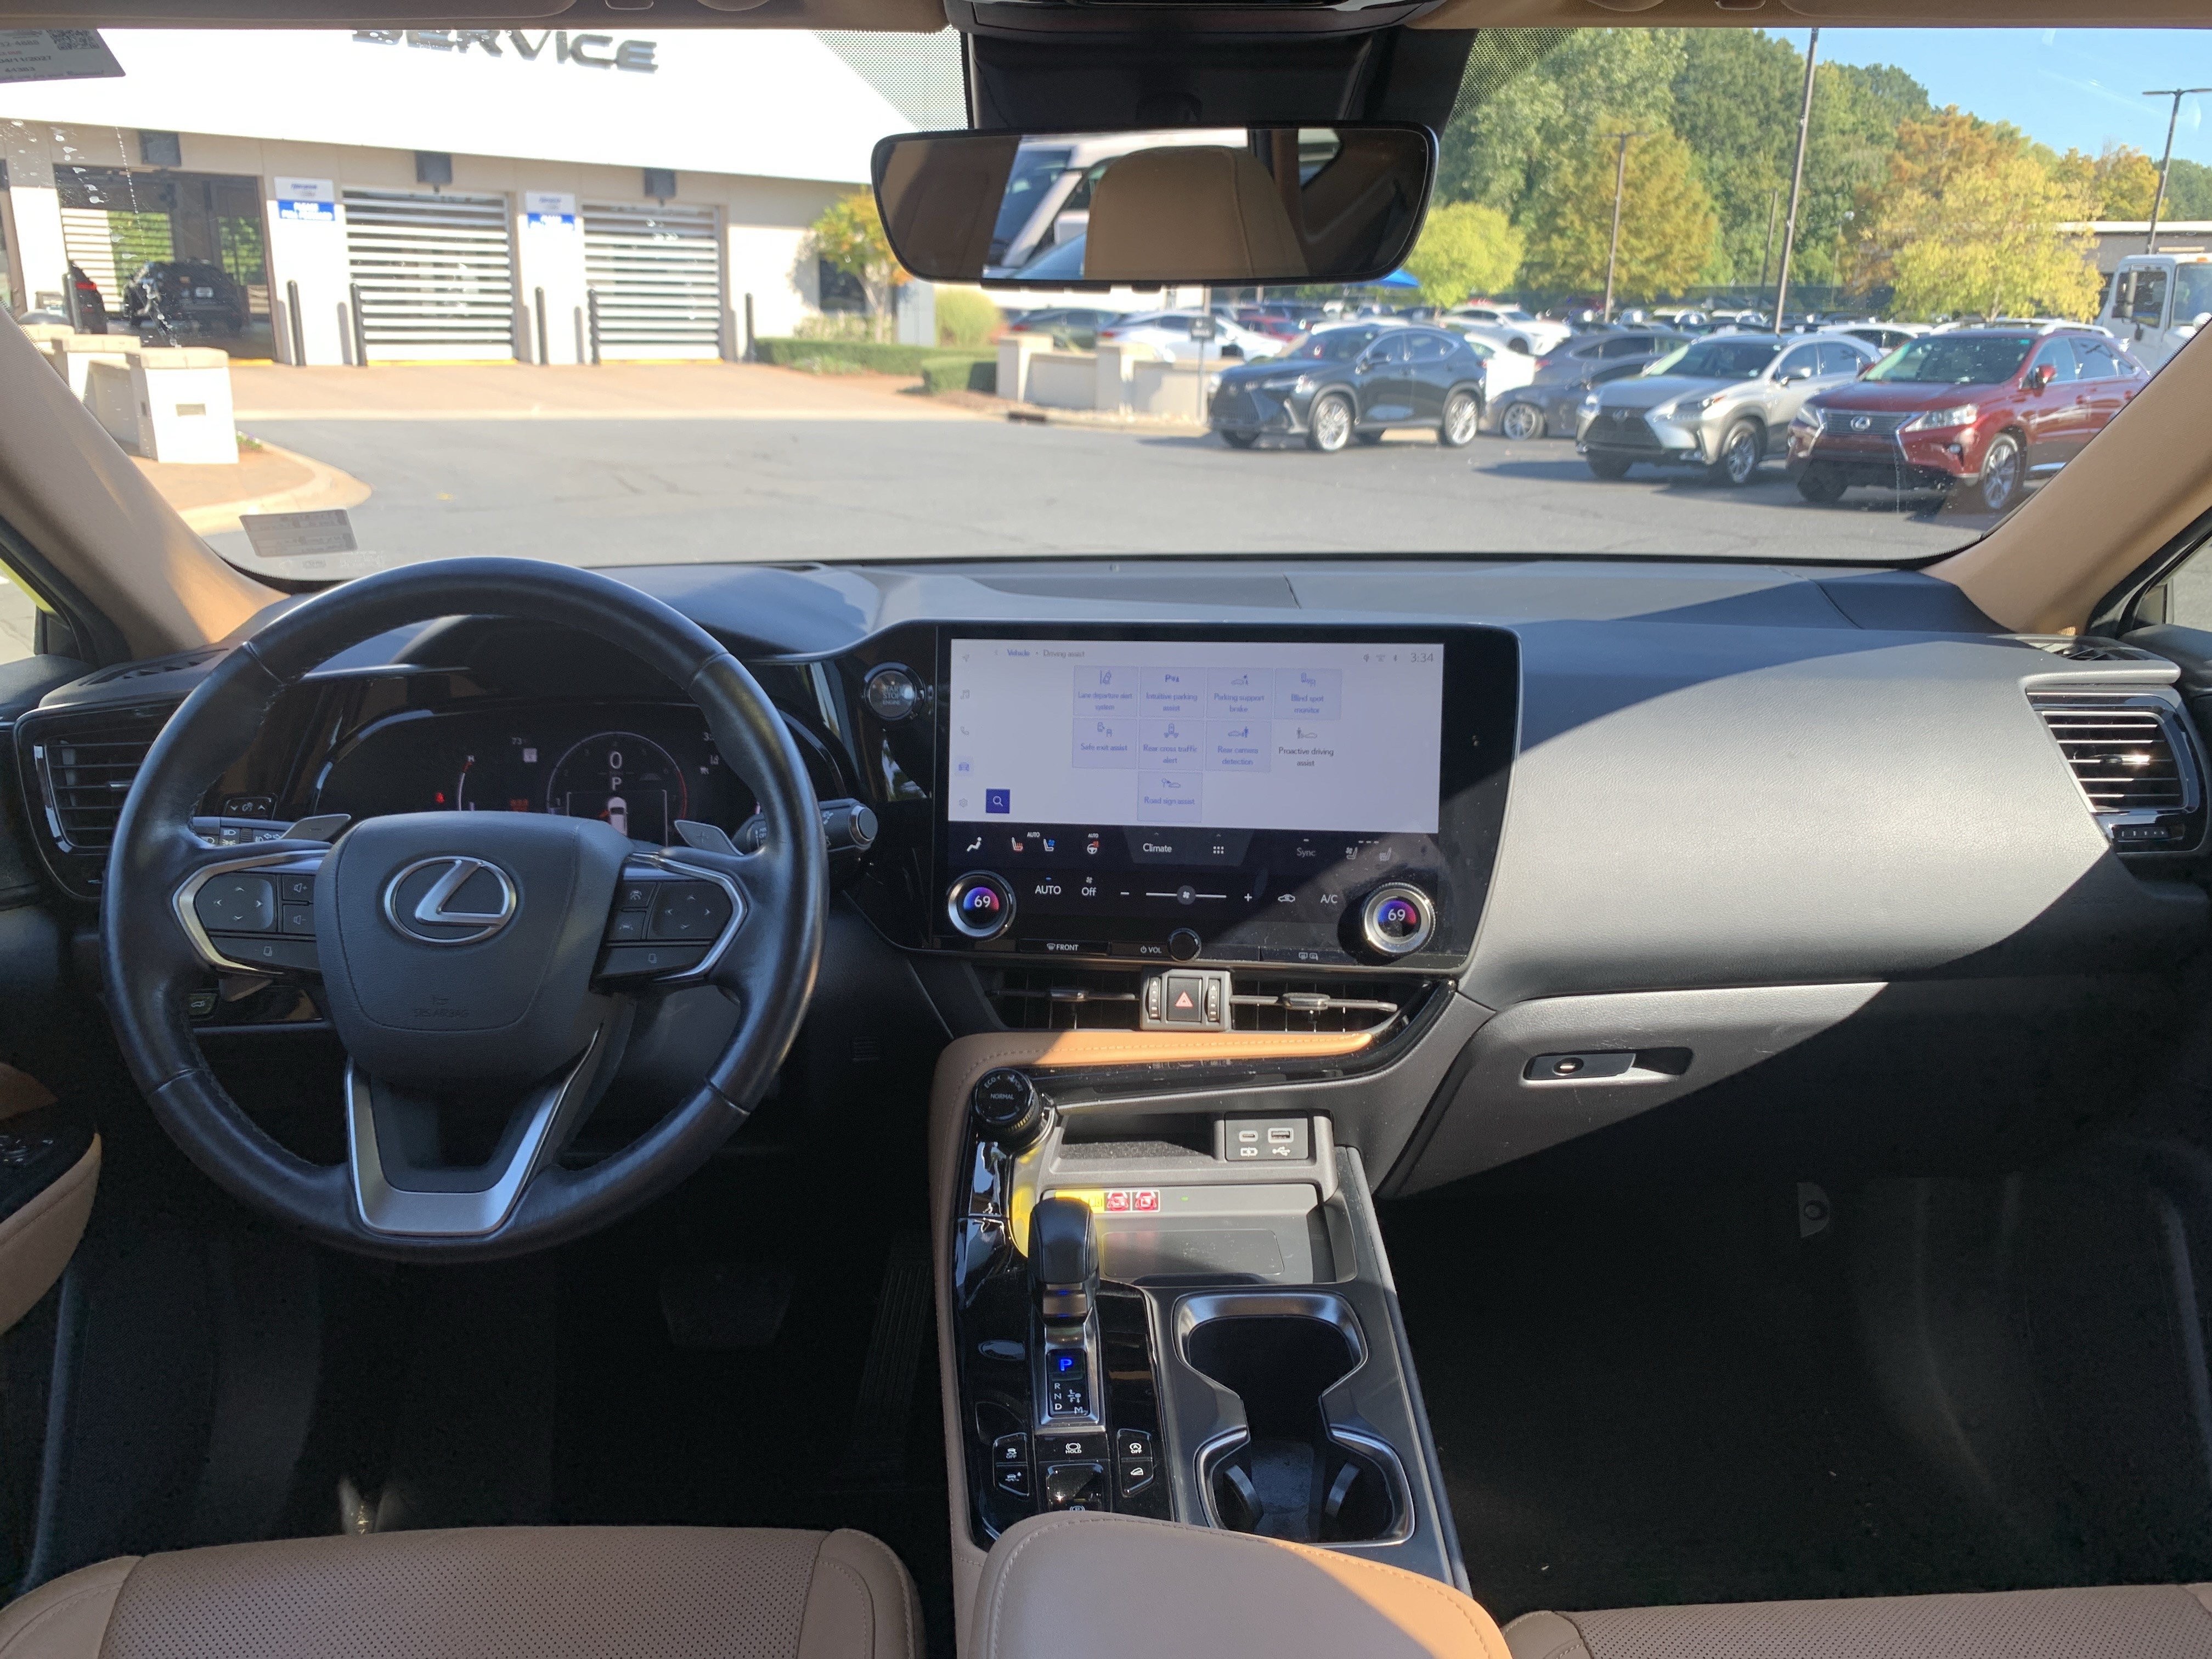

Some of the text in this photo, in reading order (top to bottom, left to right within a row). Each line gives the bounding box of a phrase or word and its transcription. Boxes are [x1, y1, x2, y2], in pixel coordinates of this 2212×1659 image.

[1043, 649, 1066, 658] Driving
[1410, 652, 1434, 663] 3:34
[1093, 692, 1119, 700] departure
[1173, 692, 1198, 701] parking
[1214, 692, 1238, 702] Parking
[1291, 693, 1307, 702] Blind
[1278, 747, 1334, 757] Proactive driving
[610, 751, 622, 769] 0
[612, 777, 622, 791] P
[1163, 798, 1176, 806] sign
[1143, 843, 1172, 853] Climate
[1297, 848, 1316, 857] Sync
[1035, 885, 1061, 894] AUTO
[1081, 887, 1097, 896] Off
[974, 895, 991, 907] 69
[1320, 894, 1338, 904] A/C
[1387, 909, 1406, 921] 69
[984, 1077, 996, 1089] ECO
[1060, 1359, 1072, 1371] P
[1074, 1406, 1084, 1414] M
